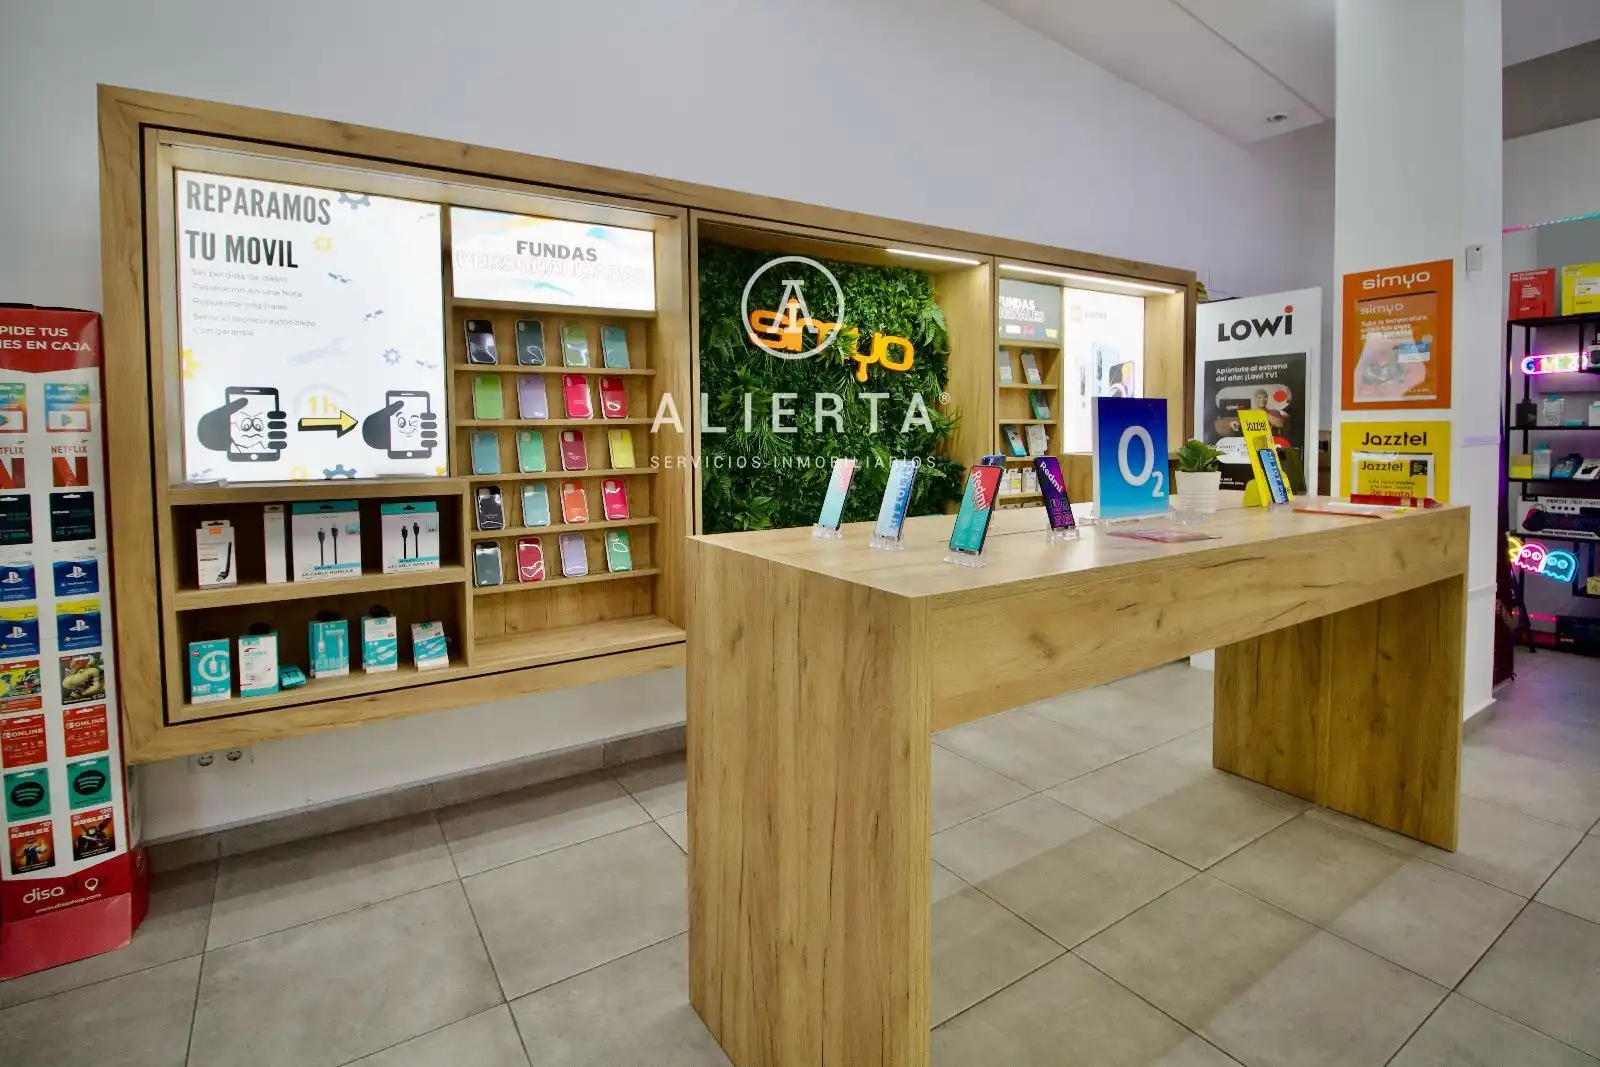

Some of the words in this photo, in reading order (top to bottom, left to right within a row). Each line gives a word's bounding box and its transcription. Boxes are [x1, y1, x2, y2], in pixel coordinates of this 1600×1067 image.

[186, 180, 331, 226] REPARAMOS
[185, 229, 216, 261] TU
[225, 234, 299, 268] MOVIL
[516, 240, 598, 262] FUNDAS
[1362, 271, 1431, 290] simyo
[999, 295, 1036, 310] FUNDAS
[1360, 303, 1404, 315] simyo
[0, 326, 36, 336] PIDE
[39, 327, 69, 337] TUS
[0, 340, 22, 349] ES
[26, 341, 47, 350] EN
[51, 341, 92, 351] CAJA
[1216, 367, 1249, 376] Apúntate
[1250, 364, 1258, 372] al
[1259, 363, 1288, 371] estreno
[1215, 374, 1227, 382] del
[307, 395, 338, 415] 1h
[1362, 432, 1427, 446] Jazztel
[51, 445, 88, 454] NETFLIX
[1361, 461, 1403, 472] Jazztel
[1039, 460, 1063, 493] Redmi
[971, 469, 990, 512] Redmi
[74, 717, 105, 727] ONLINE
[11, 727, 44, 737] ONLINE
[22, 886, 65, 904] disa
